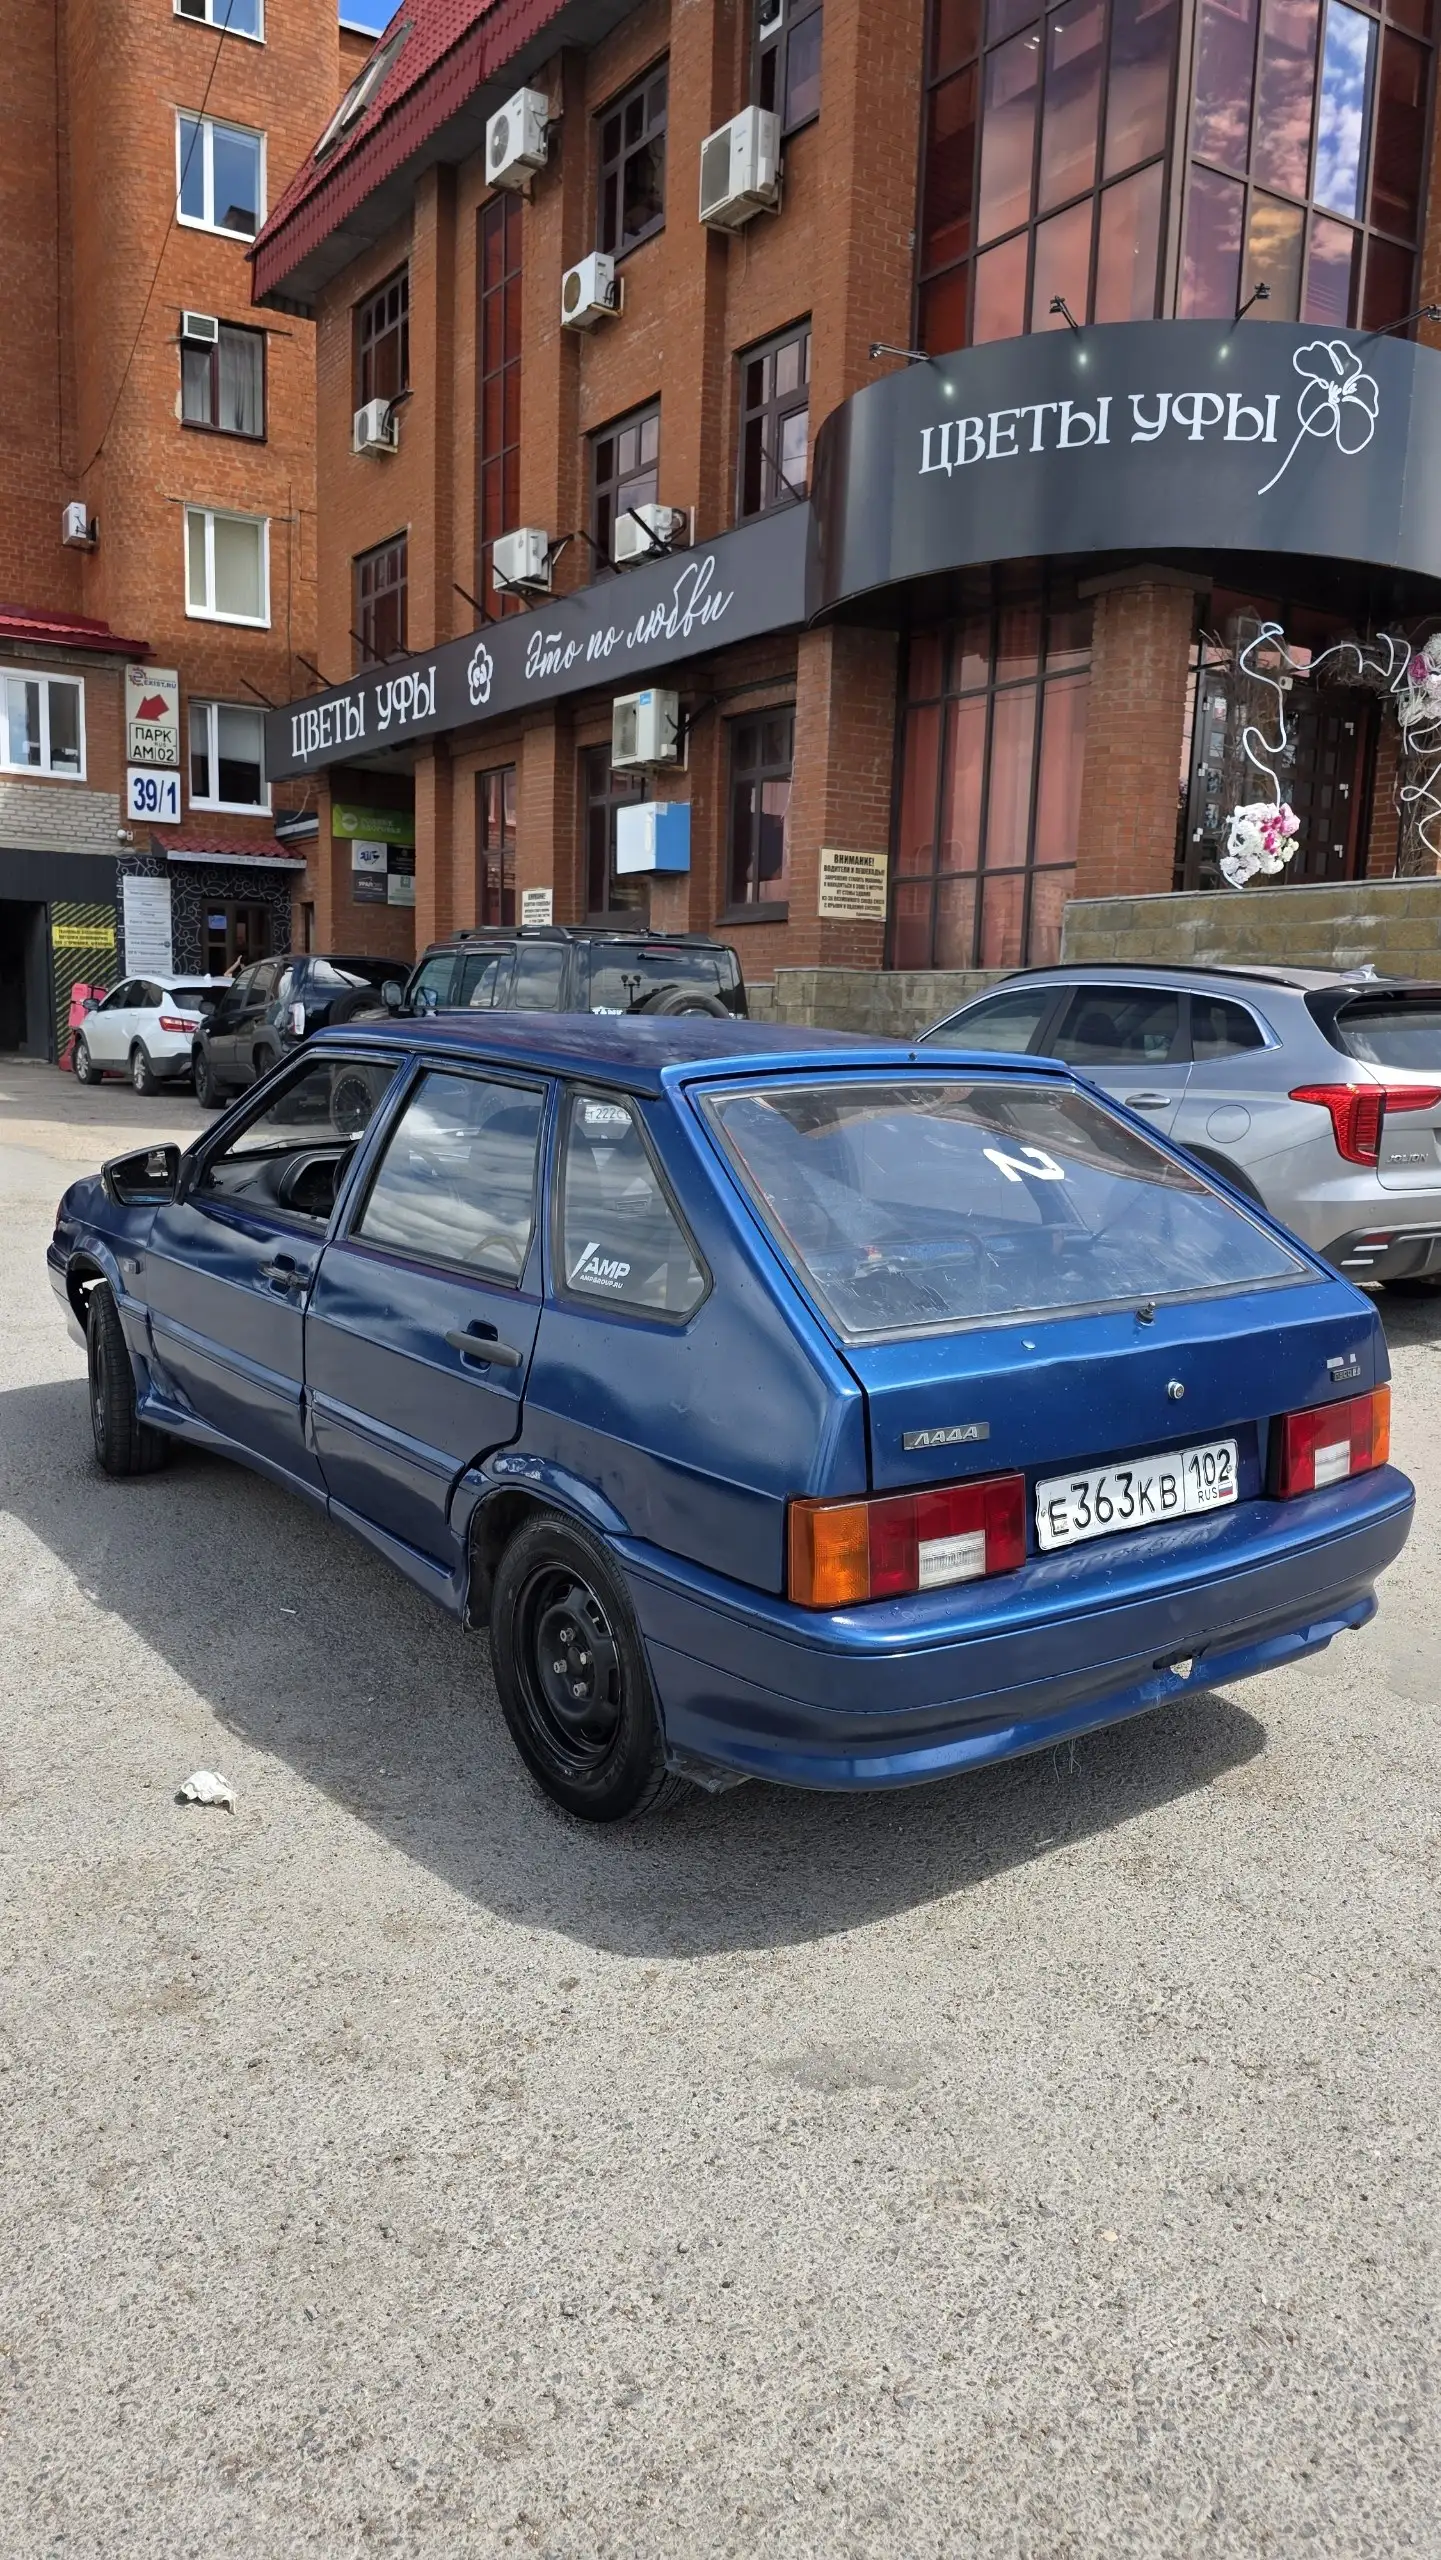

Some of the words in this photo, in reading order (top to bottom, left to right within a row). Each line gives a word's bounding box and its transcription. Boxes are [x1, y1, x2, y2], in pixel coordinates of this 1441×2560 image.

[918, 396, 1113, 477] ЦВЕТЫ
[1128, 392, 1281, 443] УФЫ
[525, 630, 584, 680] Это
[586, 626, 624, 662] по
[626, 555, 735, 649] любви
[291, 692, 365, 764] ЦВЕТЫ
[375, 665, 437, 731] УФЫ
[135, 727, 172, 743] ПАРК
[157, 748, 175, 762] 02
[133, 777, 177, 815] 39/1
[834, 854, 875, 867] ВНИМАНИЕ!
[1384, 1153, 1429, 1164] JOLION
[583, 1256, 631, 1280] AMP
[579, 1274, 624, 1289] AMPGROUP.RU
[914, 1426, 978, 1445] ЛАДА
[1049, 1471, 1177, 1536] Е363КВ
[1188, 1448, 1231, 1489] 102
[1197, 1489, 1218, 1503] RUS
